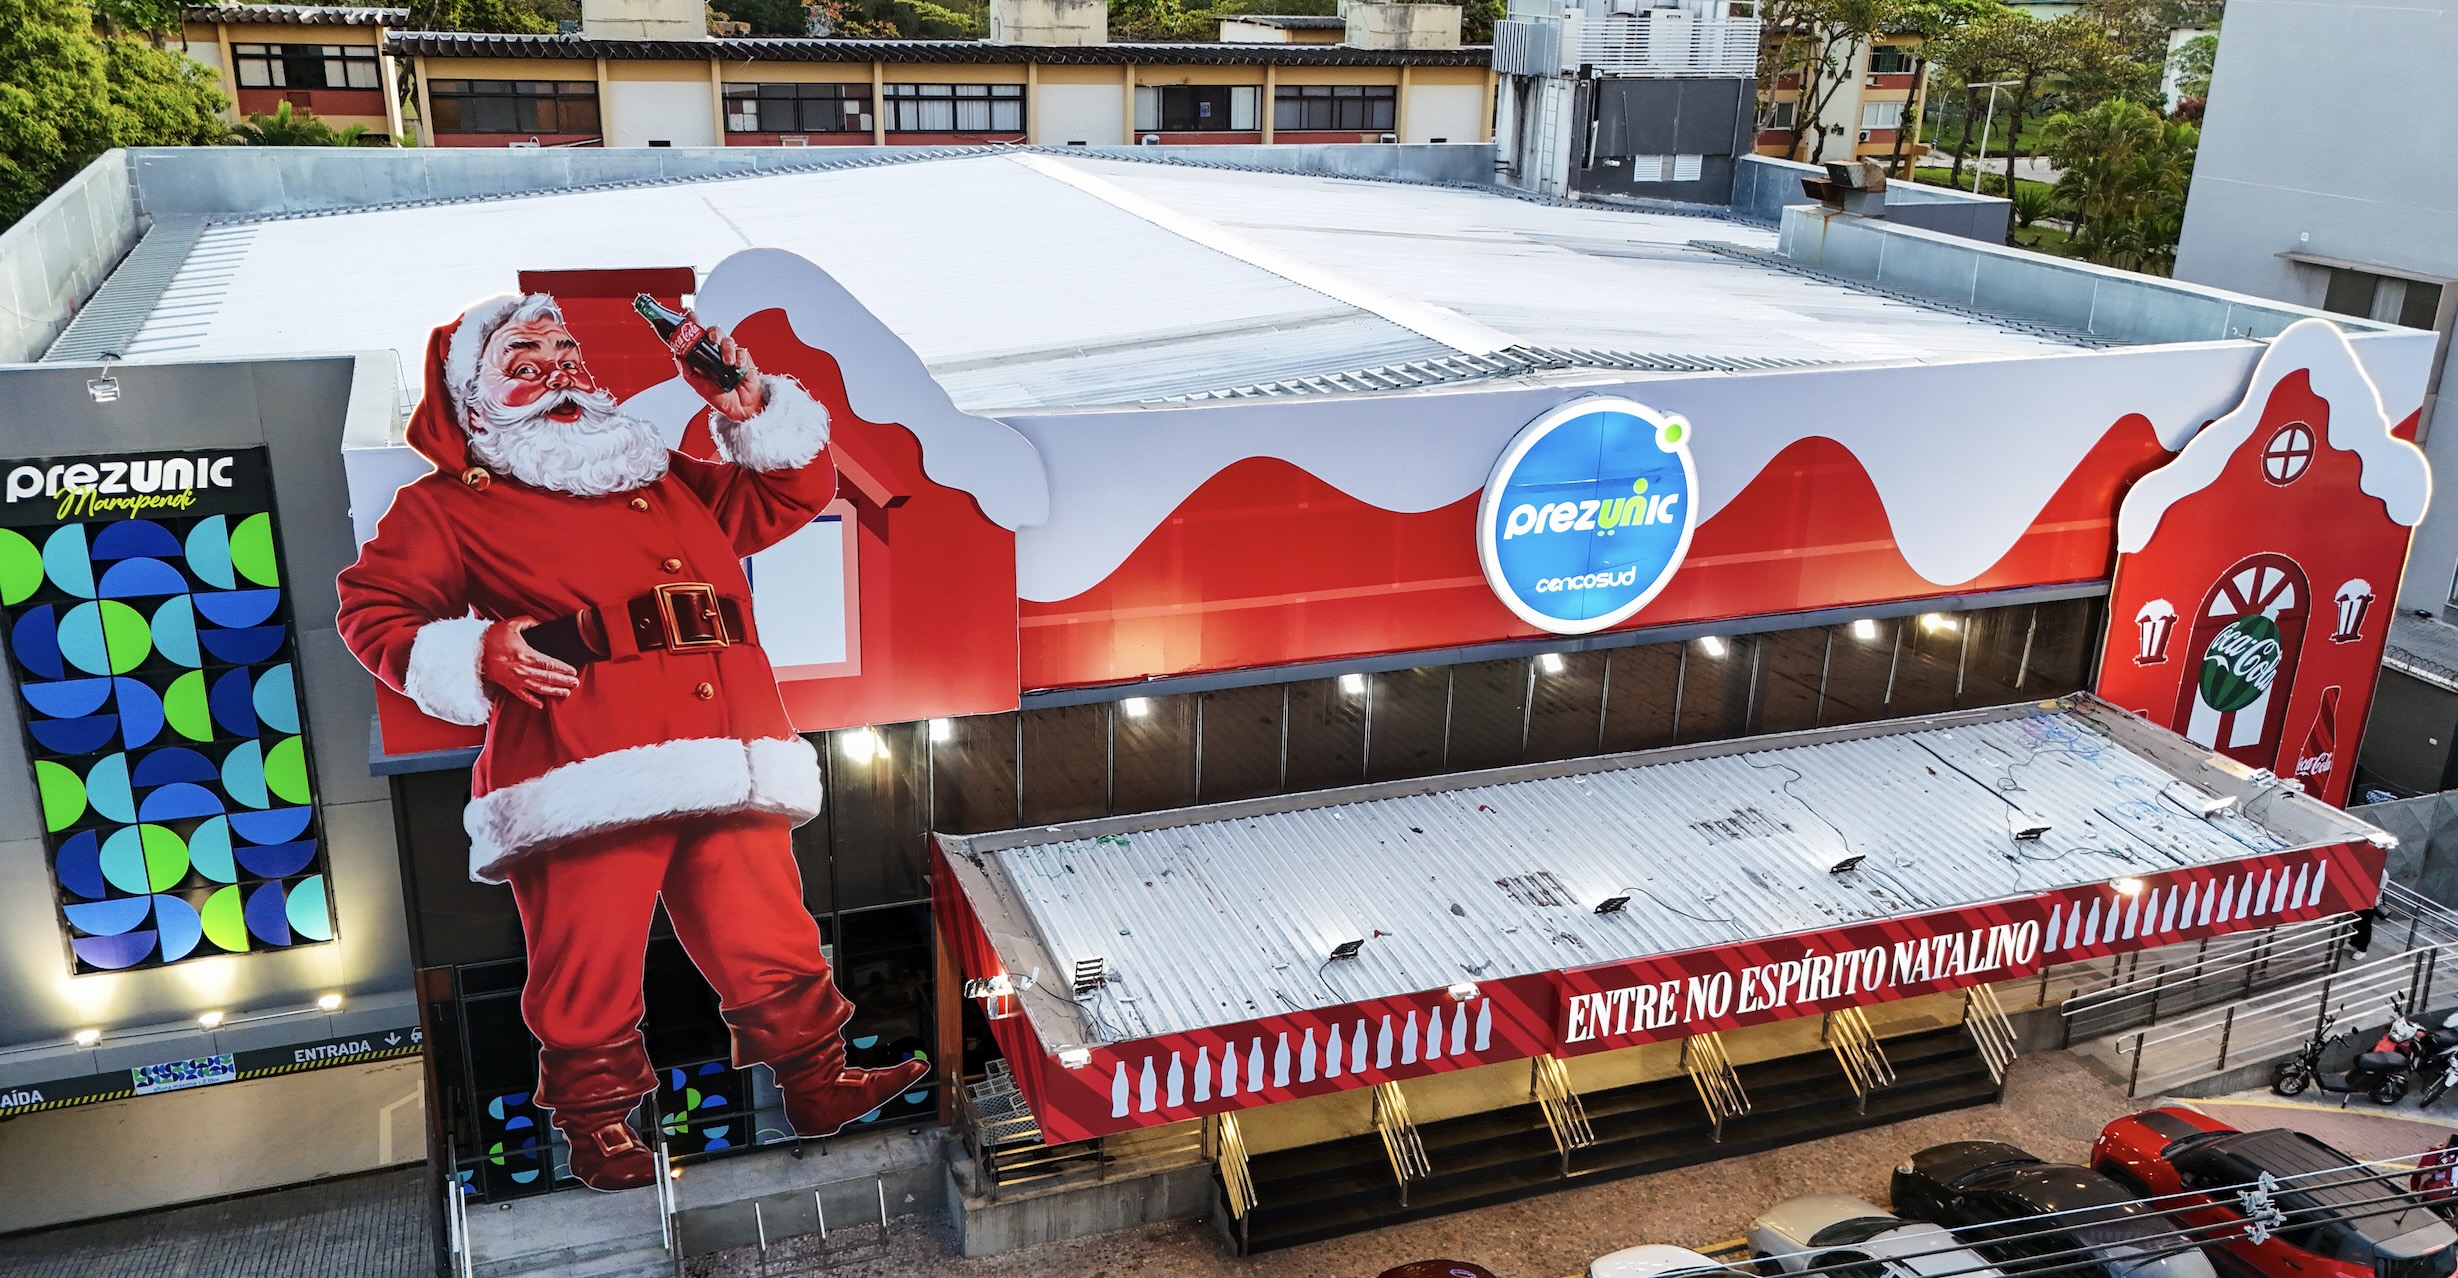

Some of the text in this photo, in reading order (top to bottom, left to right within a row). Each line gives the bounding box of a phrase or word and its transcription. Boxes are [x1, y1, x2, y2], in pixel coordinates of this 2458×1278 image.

[6, 456, 233, 503] prezunic
[52, 486, 196, 520] Marapendi
[1503, 478, 1679, 540] prezunic
[1535, 565, 1637, 593] cencosud
[1565, 920, 2040, 1044] ENTRE NO ESPÍRITO NATALINO
[294, 1039, 371, 1062] ENTRADA
[0, 1090, 44, 1108] AÍDA
